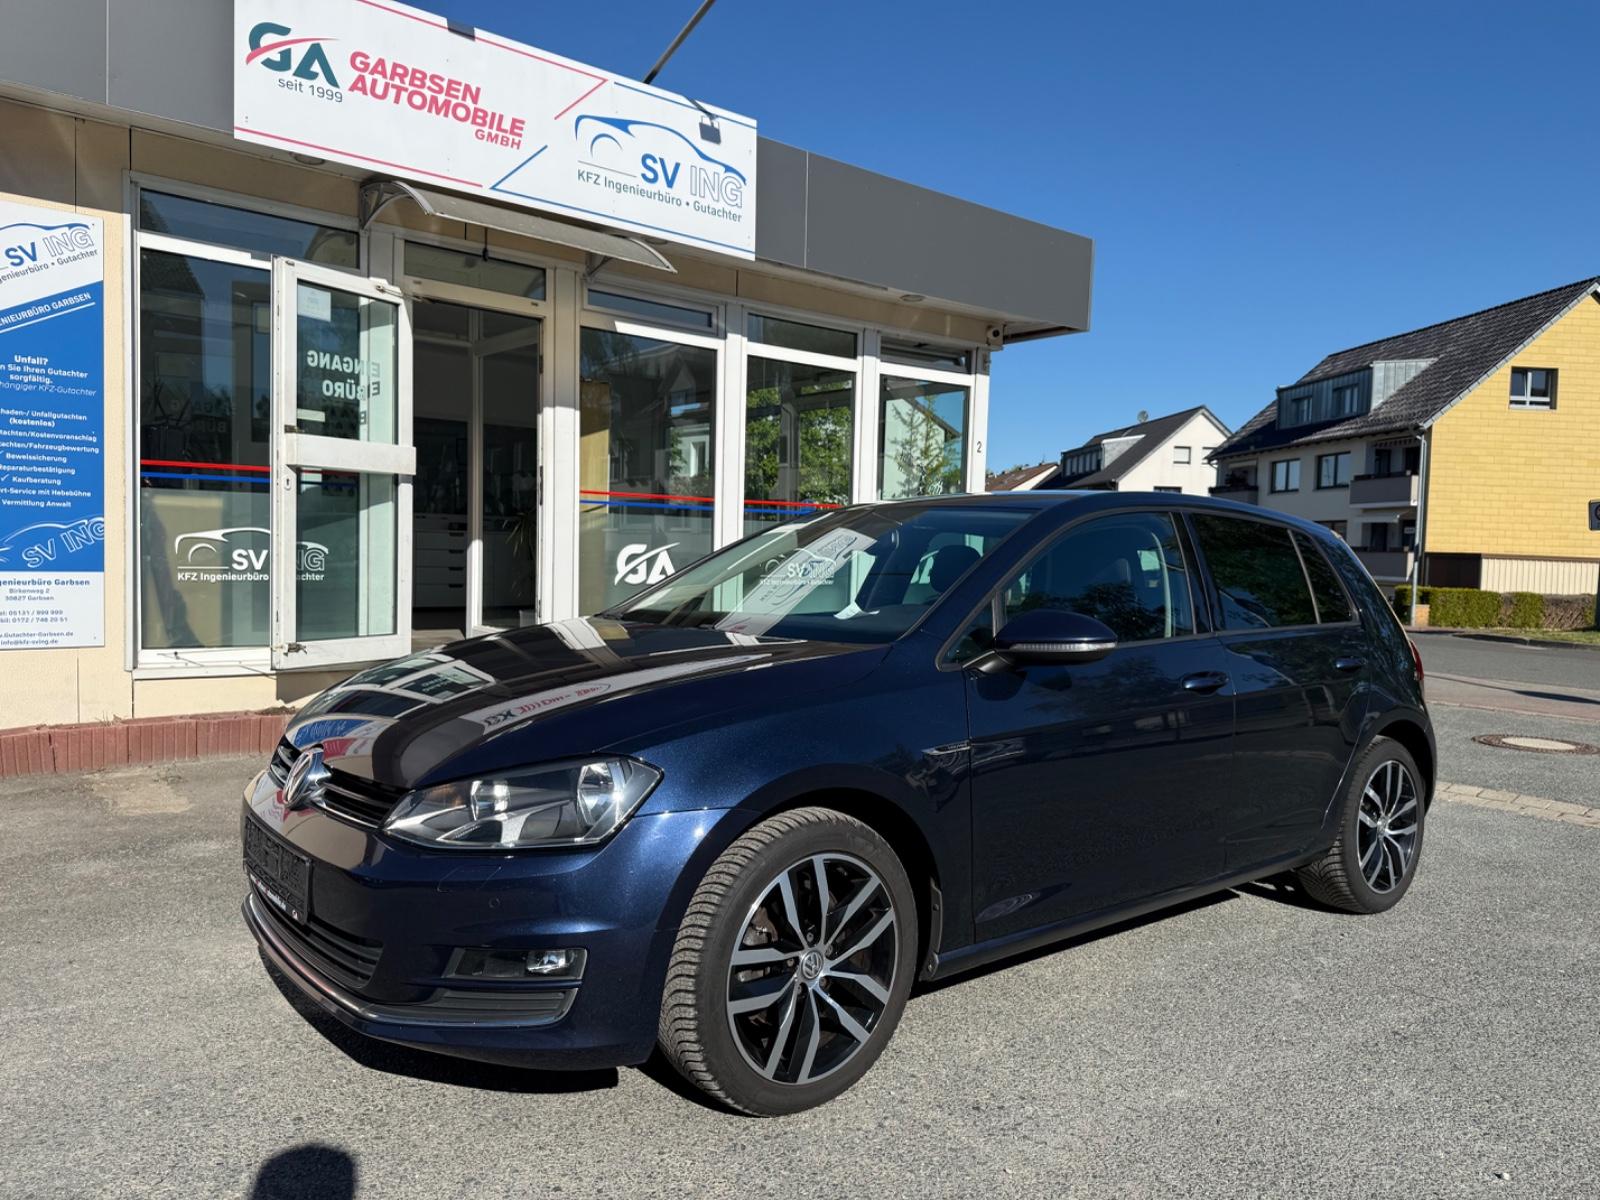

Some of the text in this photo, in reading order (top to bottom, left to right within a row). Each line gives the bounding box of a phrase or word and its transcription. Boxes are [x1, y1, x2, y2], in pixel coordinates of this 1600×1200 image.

[349, 51, 481, 105] GARBSEN
[278, 77, 343, 103] seit 1999
[348, 77, 526, 138] AUTOMOBILE
[474, 129, 522, 150] GMBH
[641, 153, 743, 209] SV ING
[577, 169, 742, 223] KFZ Ingenieurbüro Gutachter
[4, 228, 95, 267] SV ING
[56, 249, 98, 265] Gutachter
[51, 292, 91, 309] GARBSEN
[14, 355, 48, 366] Unfall?
[7, 363, 21, 372] Sie
[23, 365, 46, 375] Ihren
[47, 368, 88, 379] Gutachter
[9, 374, 53, 385] sorgfältig.
[38, 384, 97, 397] KFZ-Gutachter
[9, 417, 55, 428] (kostenlos)
[31, 410, 87, 421] Unfallgutachten
[976, 440, 983, 454] 2
[6, 452, 67, 463] Beweissicherung
[12, 476, 62, 485] Kaufberatung
[2, 499, 72, 508] Vermittlung Anwalt
[22, 538, 57, 568] SV
[232, 549, 268, 571] SV
[54, 578, 91, 586] Garbsen
[177, 572, 198, 581] KFZ
[200, 571, 270, 582] Ingenieurbüro
